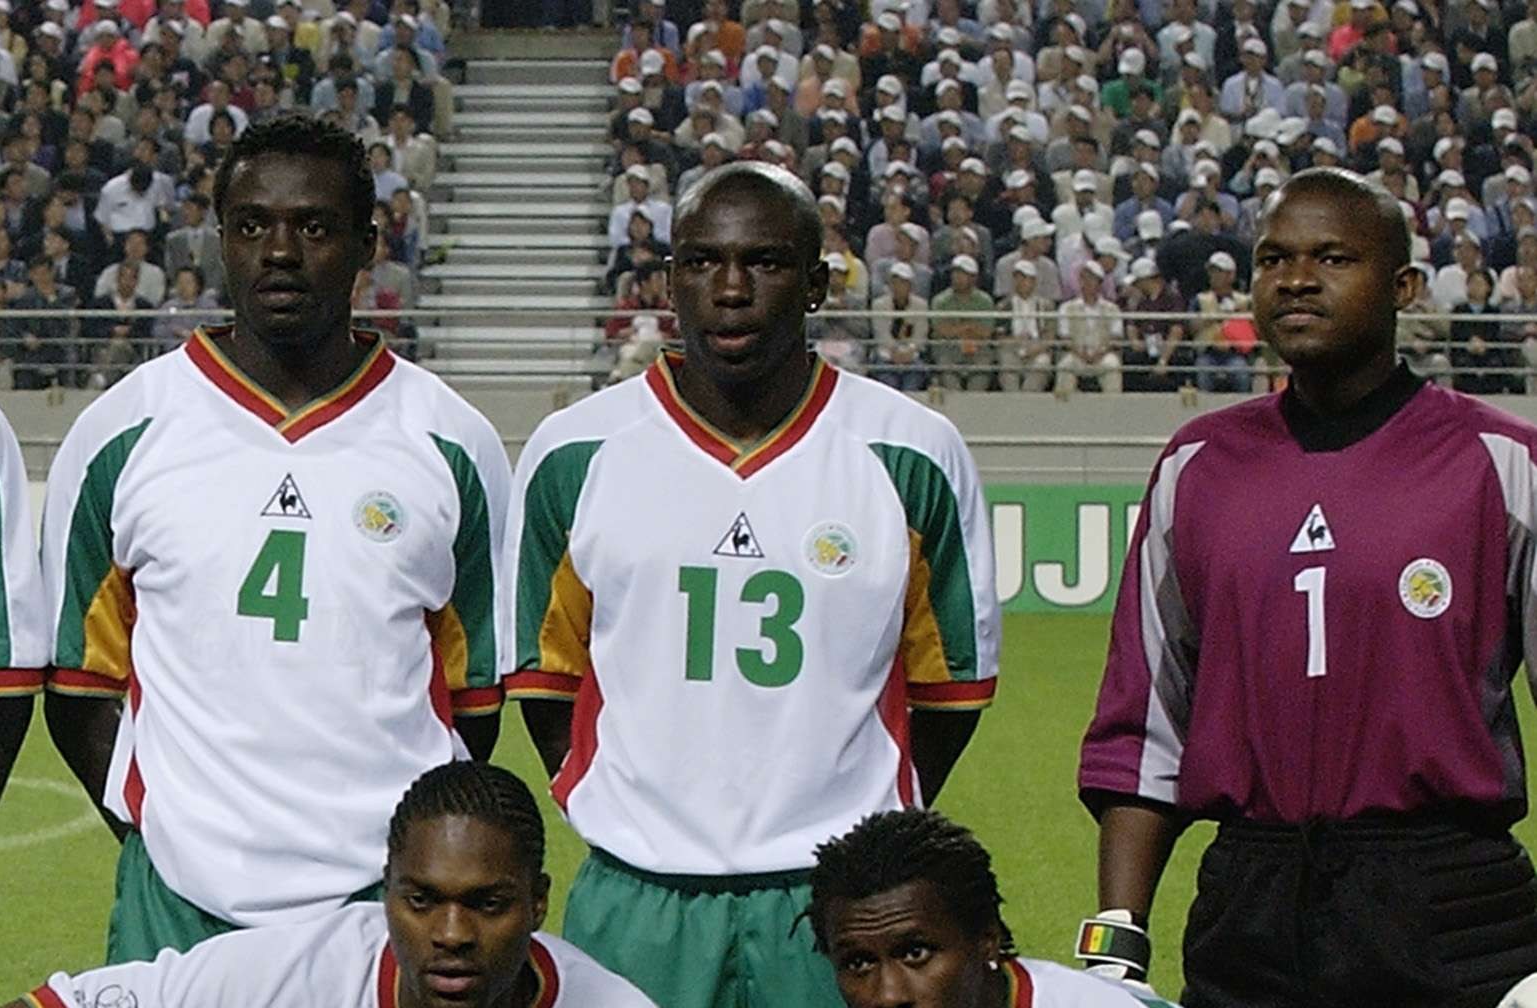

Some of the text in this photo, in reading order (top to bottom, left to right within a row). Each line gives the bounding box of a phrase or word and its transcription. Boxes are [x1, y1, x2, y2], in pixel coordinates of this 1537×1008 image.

[238, 530, 308, 641] 4
[679, 566, 804, 687] 13
[1294, 567, 1327, 677] 1
